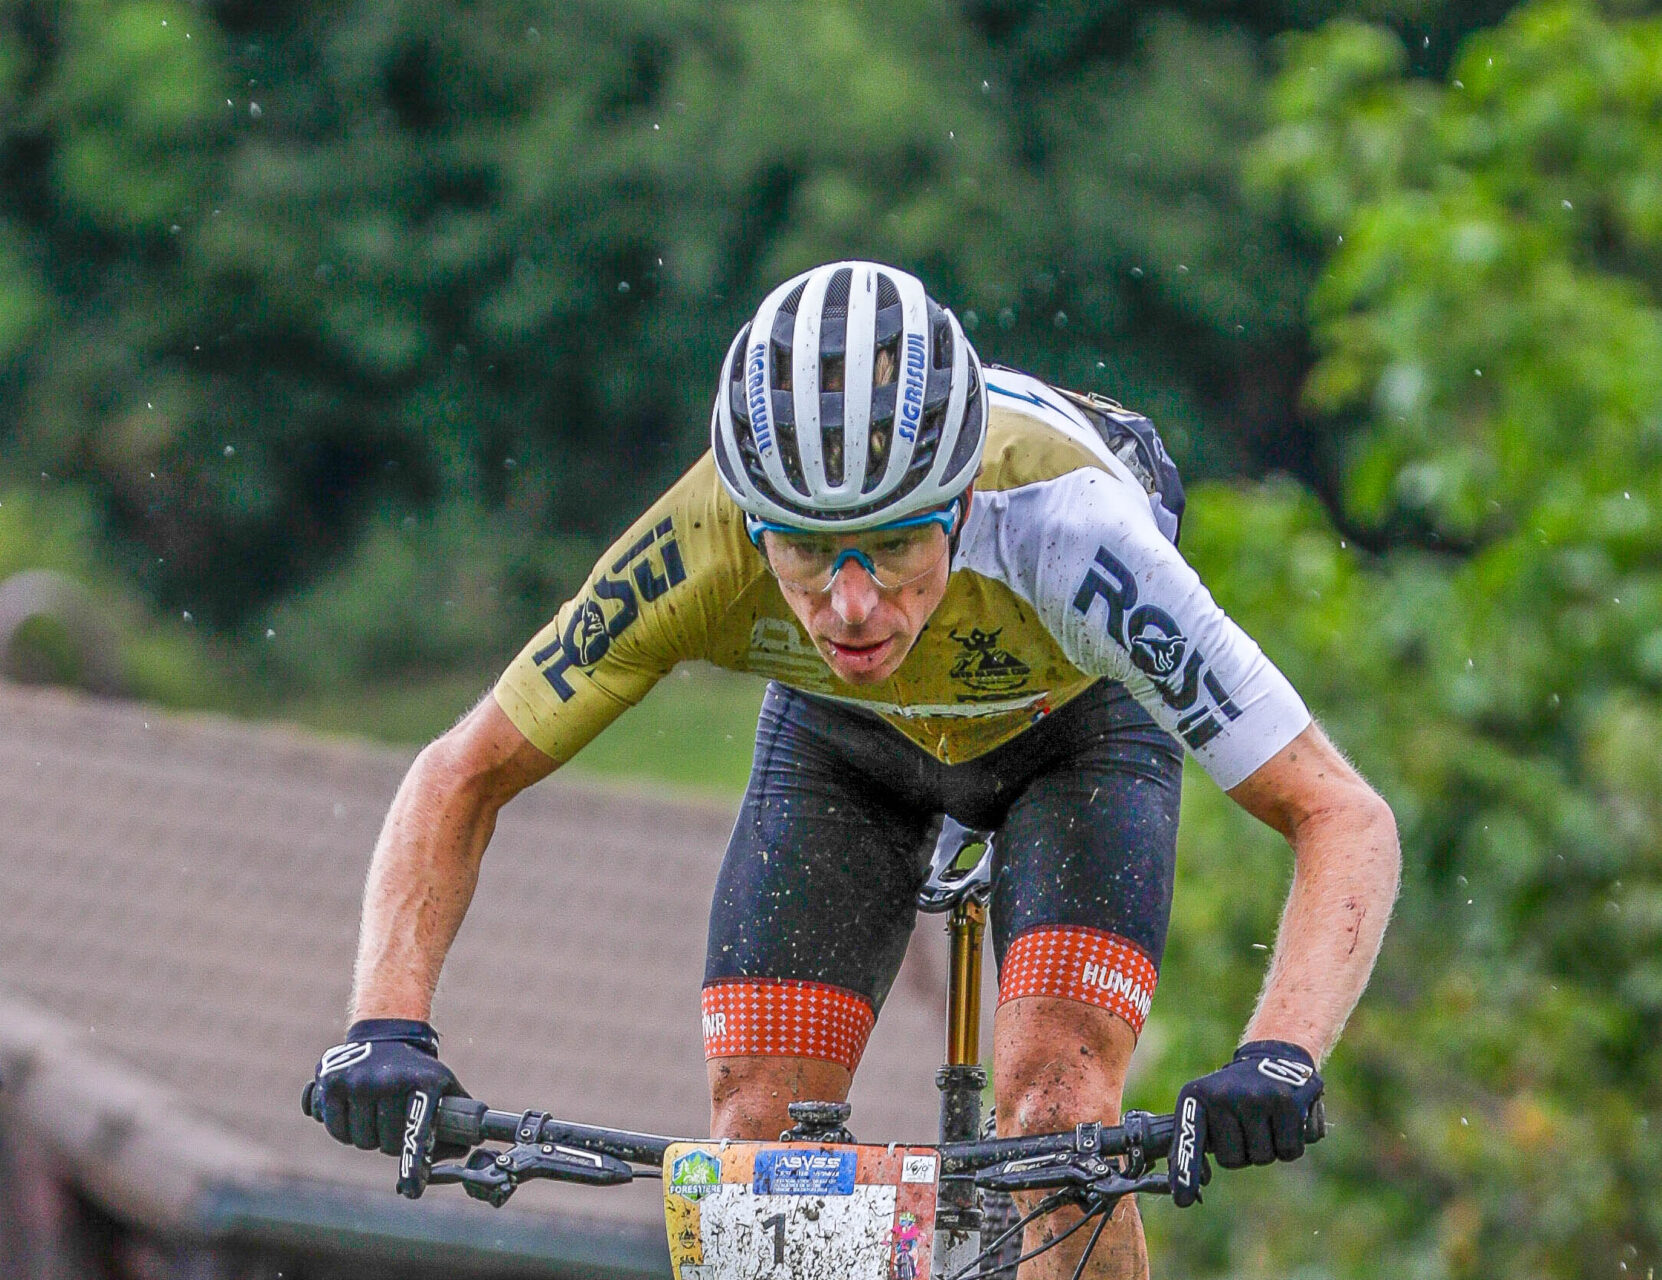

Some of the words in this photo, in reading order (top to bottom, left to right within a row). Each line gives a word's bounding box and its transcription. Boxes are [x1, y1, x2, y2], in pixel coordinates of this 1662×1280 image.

[531, 515, 687, 703] ROSE
[1072, 544, 1244, 751] ROSE
[762, 1213, 786, 1264] 1
